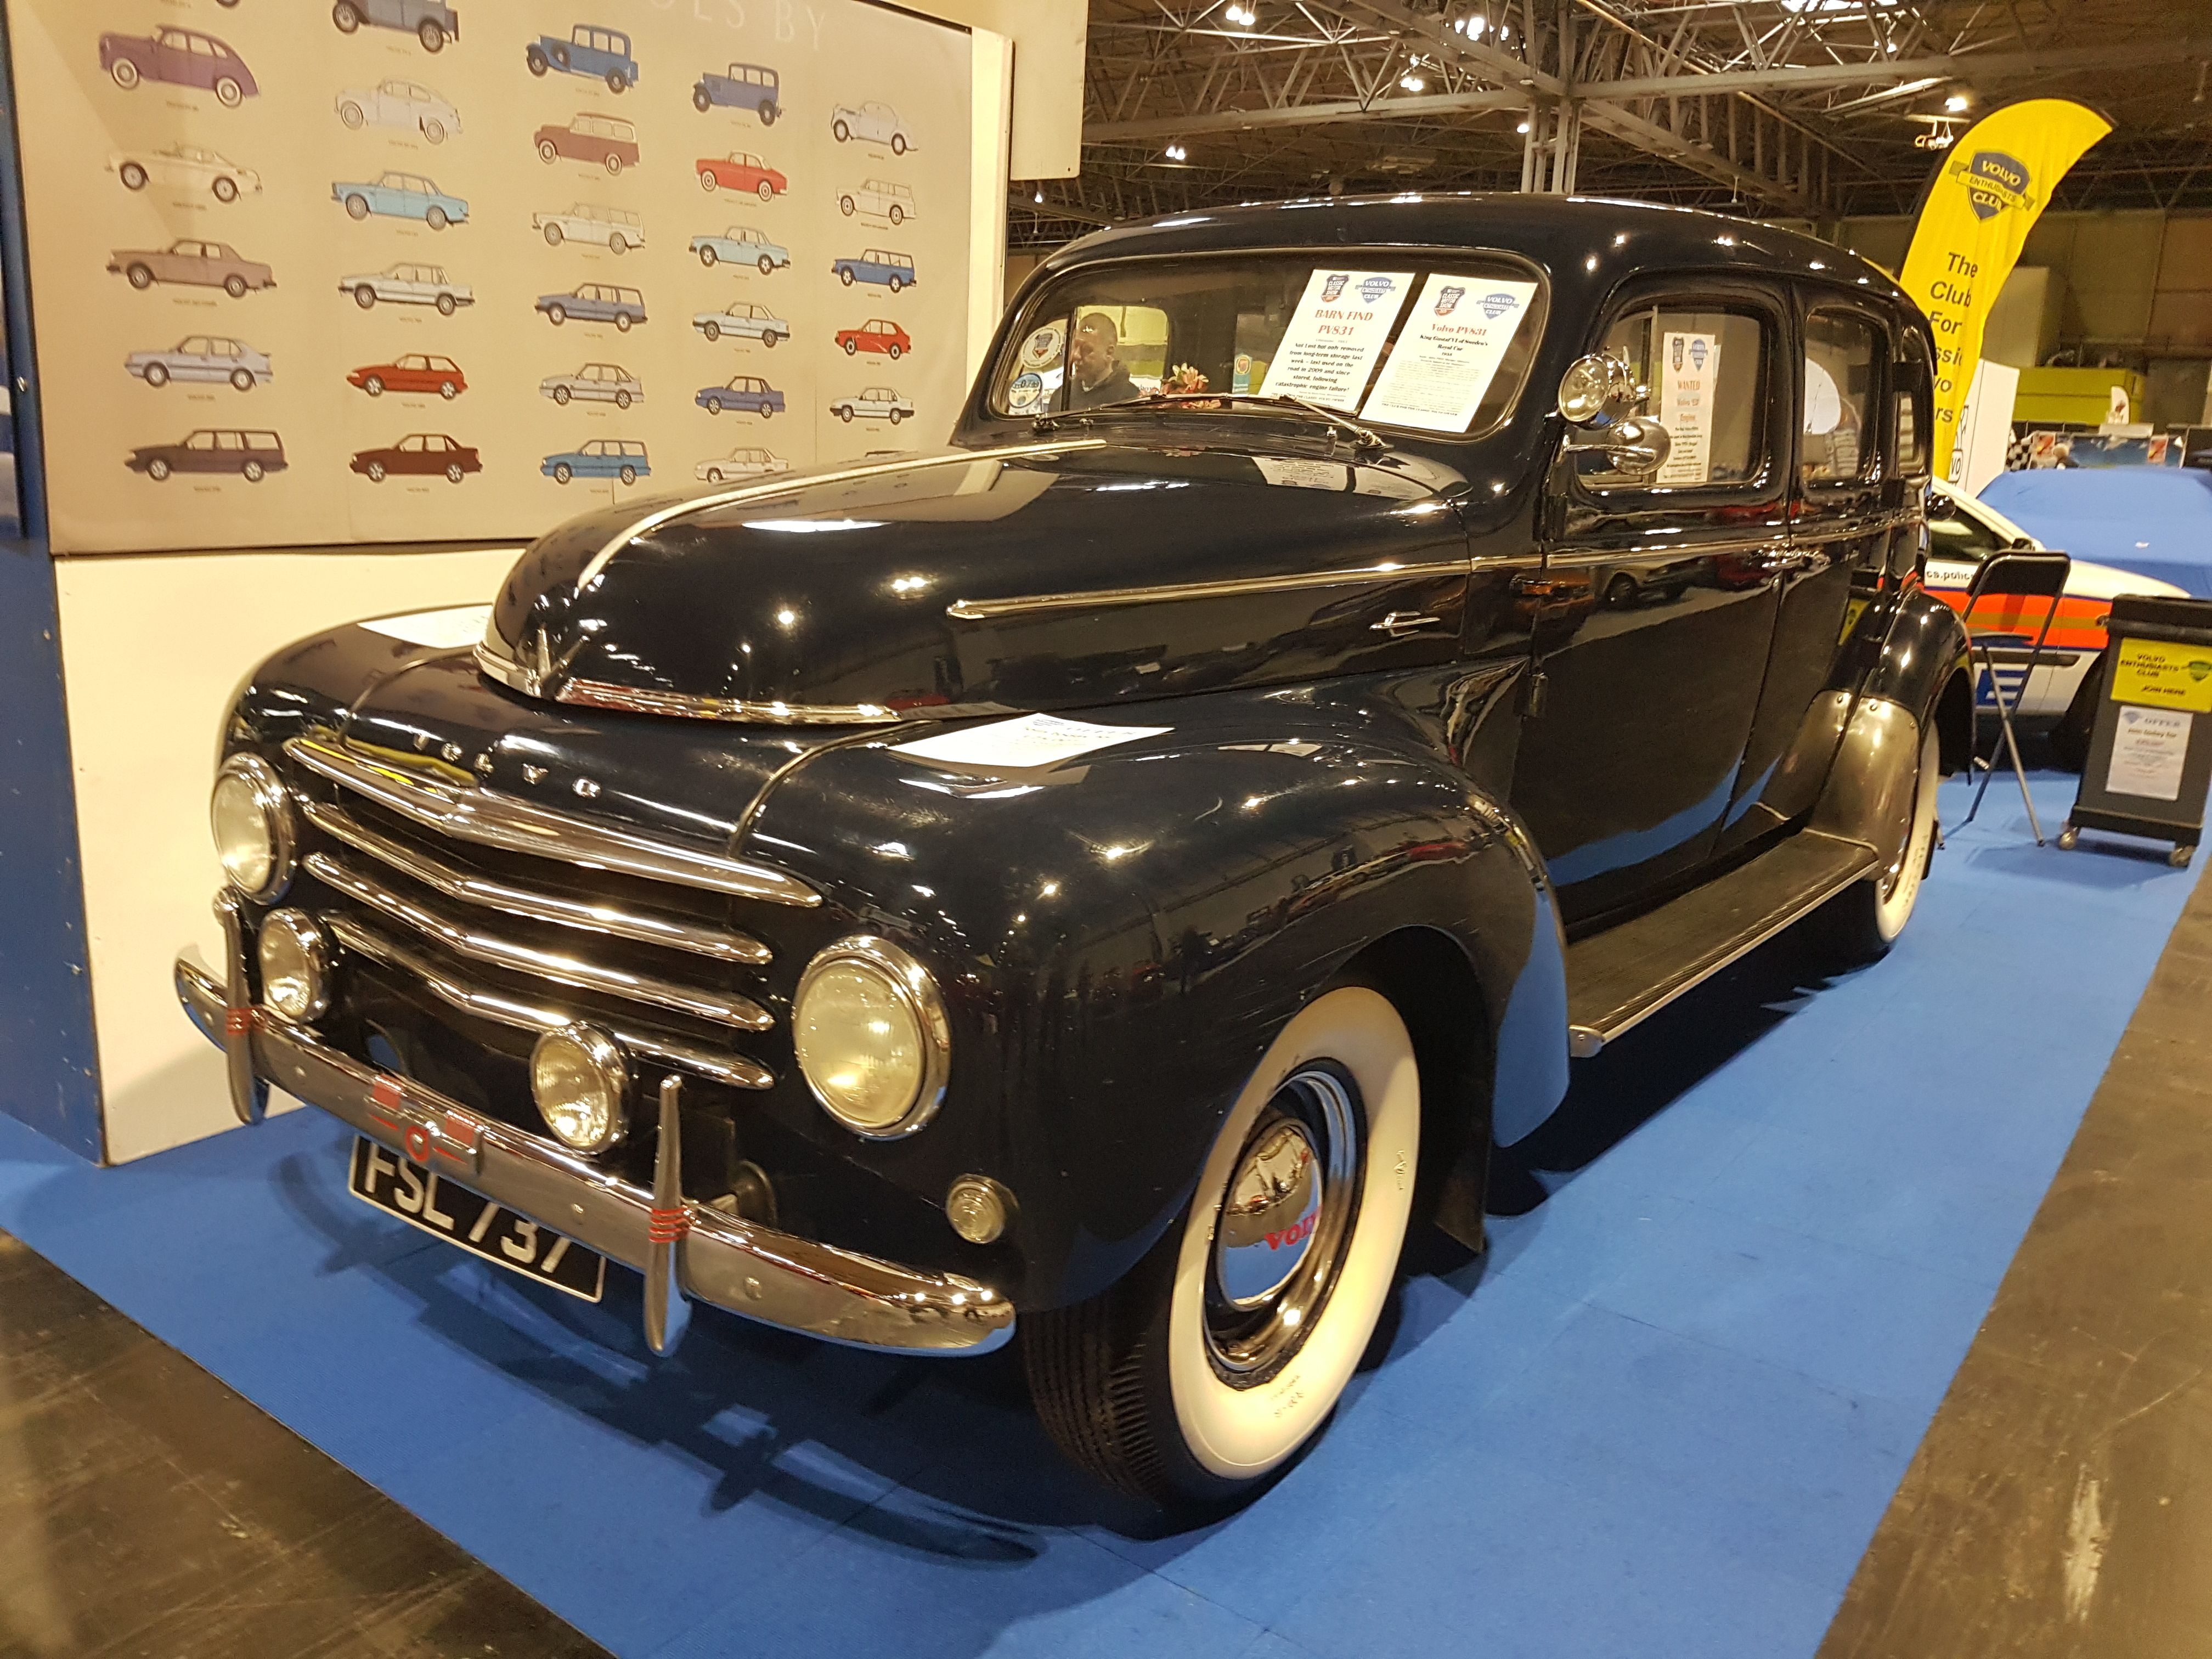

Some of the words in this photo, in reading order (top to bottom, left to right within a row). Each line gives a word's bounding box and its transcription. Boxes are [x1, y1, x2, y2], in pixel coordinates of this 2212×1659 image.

[776, 0, 826, 51] BY
[1983, 160, 2021, 186] VOLVO
[1948, 252, 1978, 278] The
[1931, 281, 1971, 307] Club
[1315, 310, 1345, 319] BARN
[1347, 311, 1373, 321] FIND
[1318, 325, 1355, 335] PV831
[1432, 324, 1454, 332] Volvo
[1456, 326, 1487, 336] PV831
[1929, 311, 1962, 336] For
[1678, 380, 1700, 390] WANTED
[2137, 653, 2165, 662] VOLVO
[2120, 659, 2179, 672] ENTHUSIASTS
